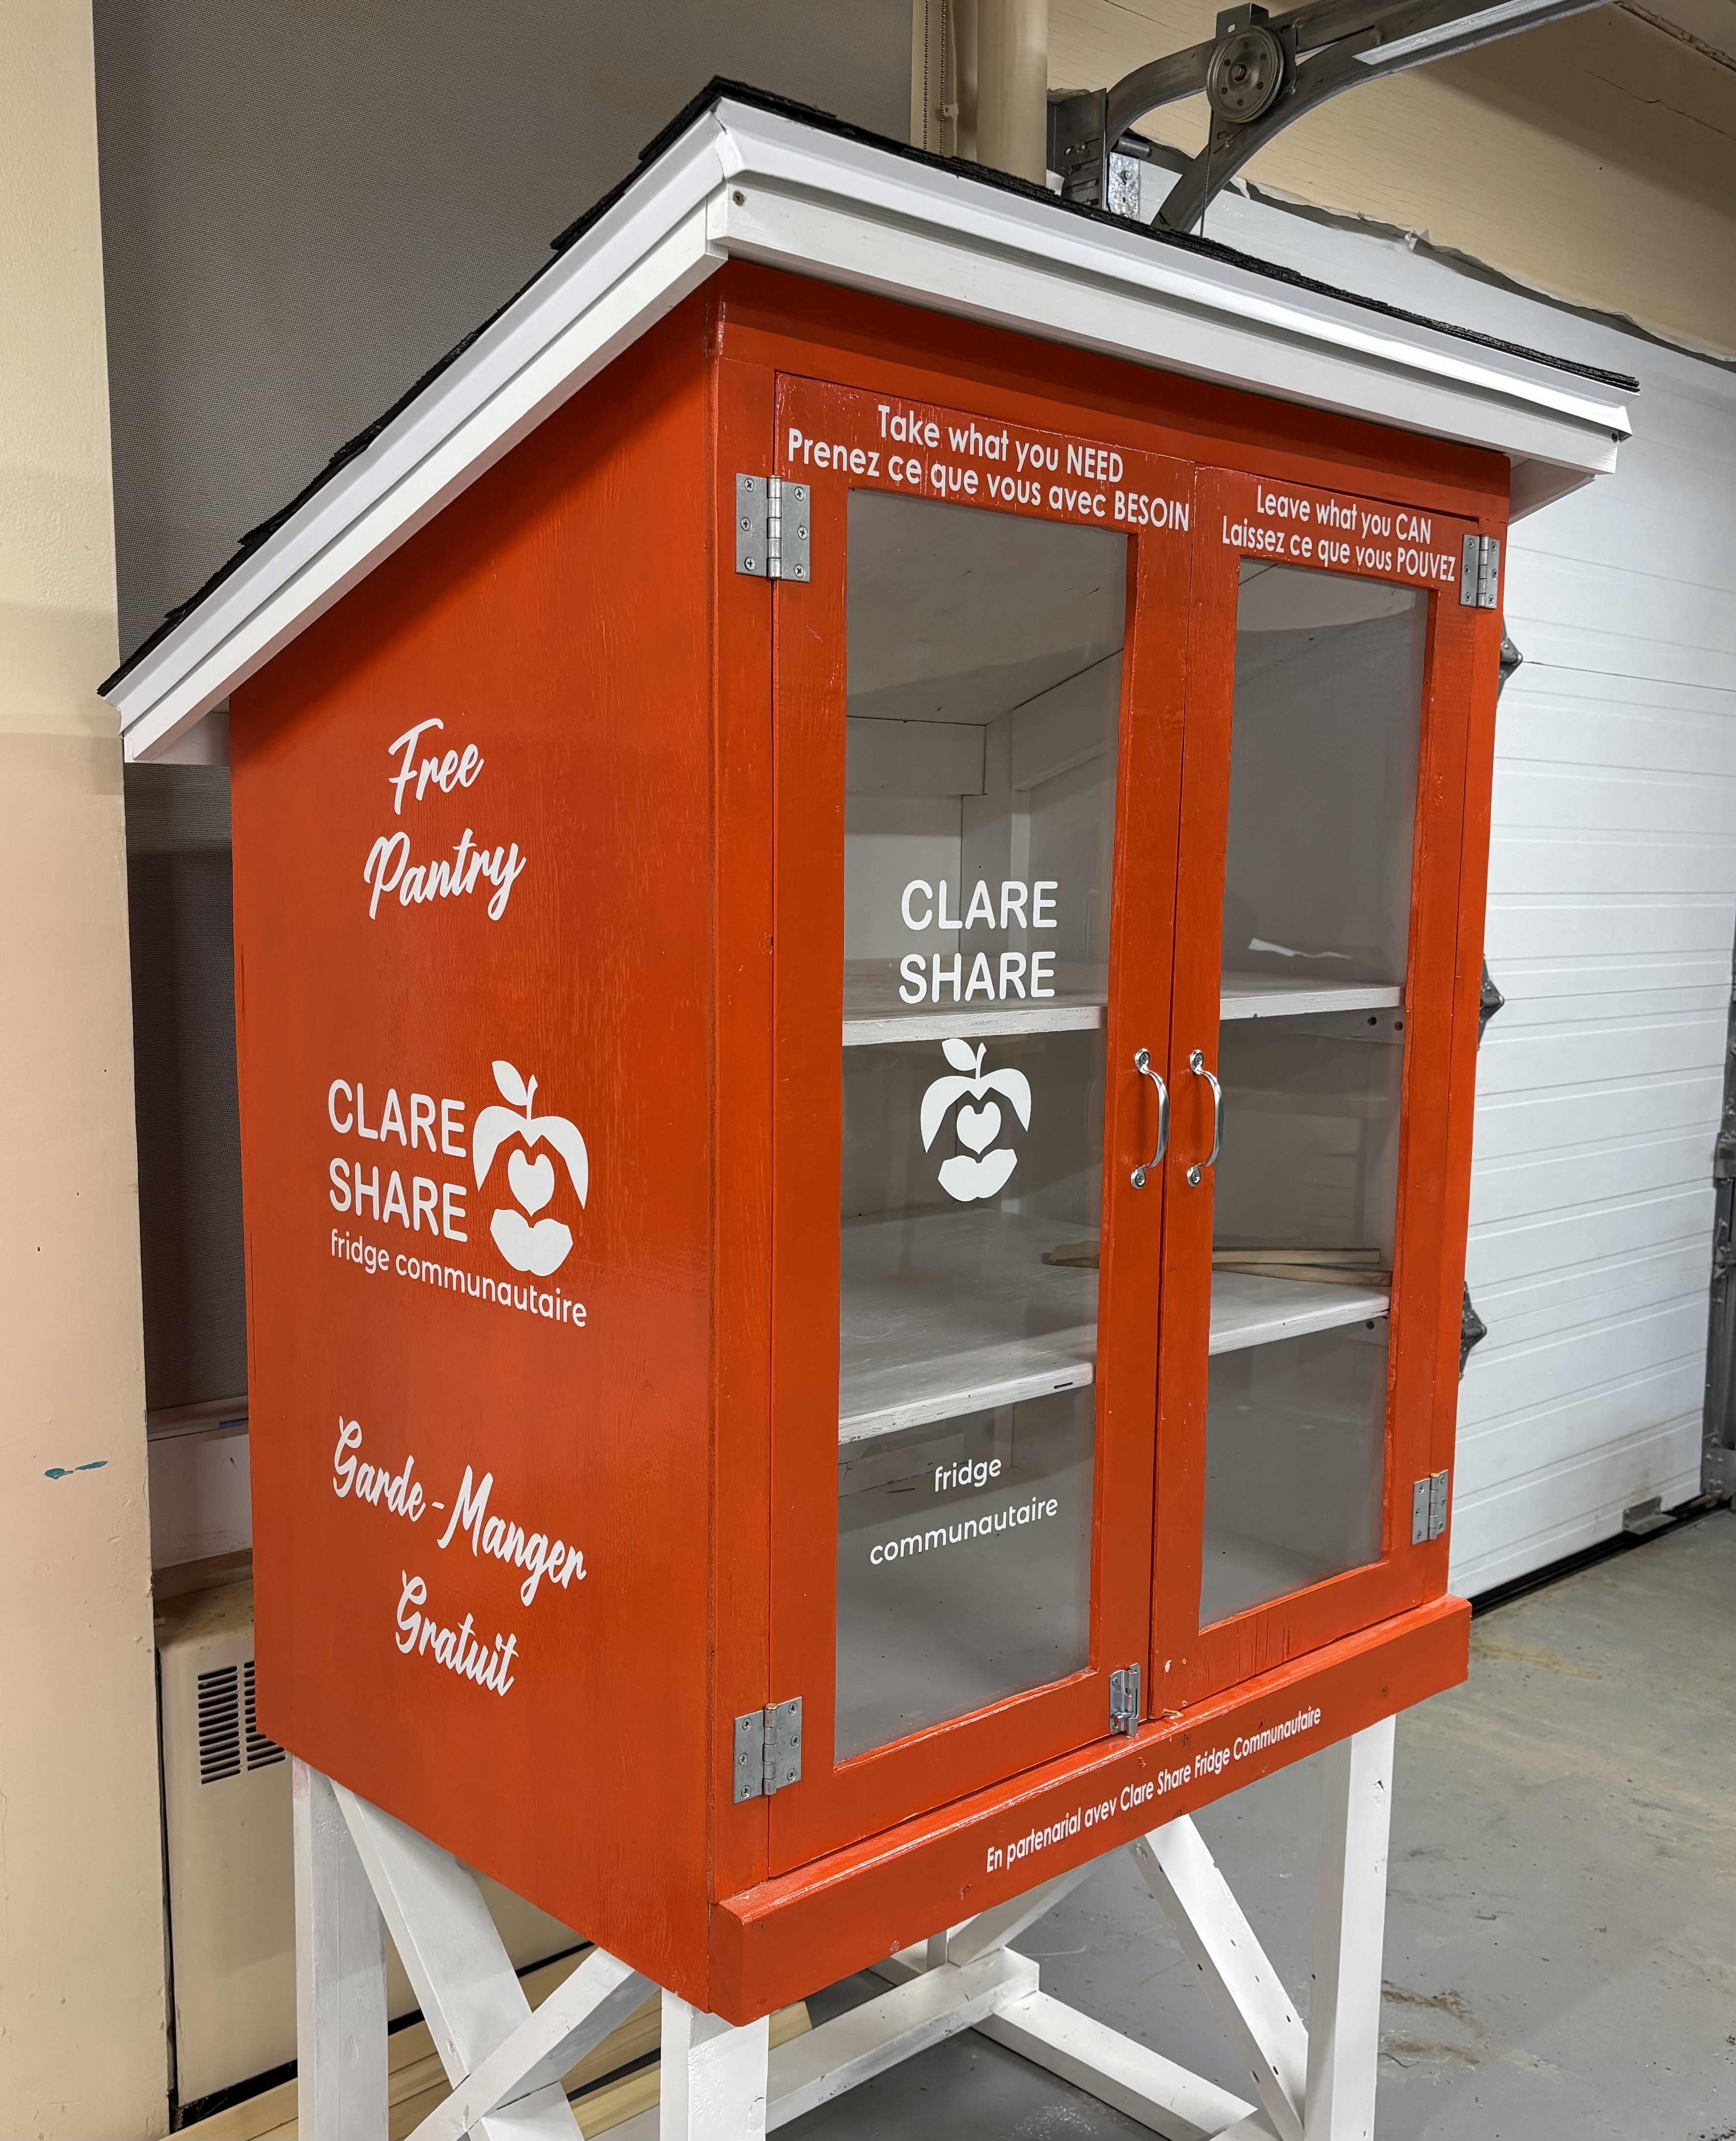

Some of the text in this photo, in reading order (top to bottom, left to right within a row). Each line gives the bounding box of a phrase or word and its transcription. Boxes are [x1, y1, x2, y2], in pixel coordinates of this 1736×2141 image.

[788, 427, 1190, 532] Prenez ce que vous avec BESOIN
[877, 404, 1123, 483] Take what you NEED
[1222, 515, 1456, 582] Laissez ce que vous POUVEZ
[1257, 485, 1432, 545] Leave what you CAN
[387, 717, 485, 815] Free
[363, 827, 527, 921] Pantry
[900, 879, 1058, 931] CLARE
[898, 950, 1057, 1004] SHARE
[327, 1079, 467, 1158] CLARE
[329, 1157, 468, 1243] SHARE
[331, 1228, 587, 1328] fridge communautaire
[332, 1415, 587, 1607] Garde-Manger
[934, 1458, 1002, 1492] fridge
[869, 1496, 1058, 1565] communautaire
[395, 1570, 519, 1697] Gratuit
[986, 1707, 1321, 1873] En partenarial avev Clare Share Fridge Communautaire
